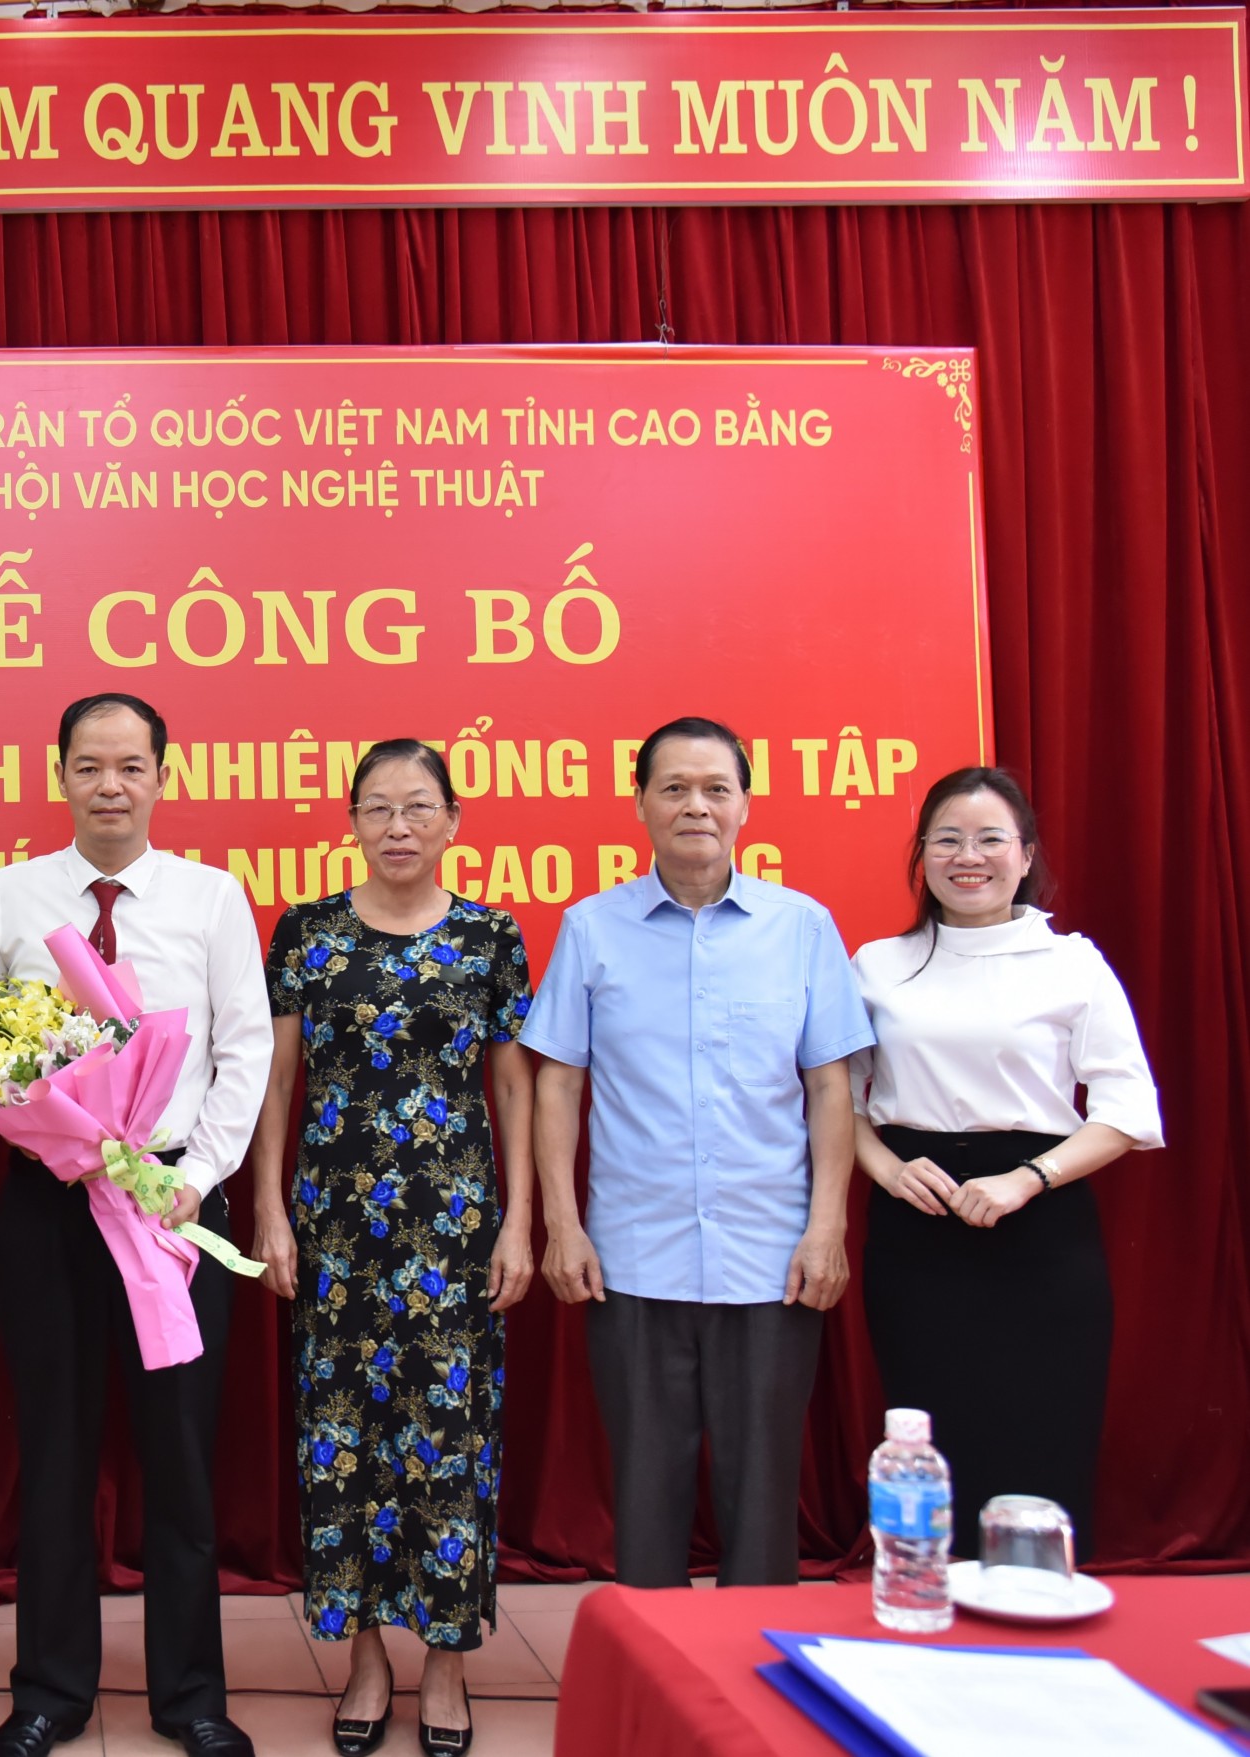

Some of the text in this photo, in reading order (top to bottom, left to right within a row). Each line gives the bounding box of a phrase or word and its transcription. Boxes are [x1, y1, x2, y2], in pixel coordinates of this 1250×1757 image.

[83, 81, 398, 165] QUANG
[422, 81, 649, 155] VINH
[672, 52, 932, 156] MUÔN
[958, 55, 1160, 152] NĂM
[79, 393, 137, 448] TỔ
[151, 394, 281, 448] QUỐC
[295, 399, 383, 456] VIỆT
[396, 408, 489, 446] NAM
[502, 396, 595, 446] TỈNH
[608, 408, 701, 446] CAO
[715, 392, 833, 447] BẰNG
[74, 462, 158, 509] VĂN
[173, 470, 268, 519] HỌC
[282, 460, 399, 518] NGHỆ
[410, 460, 545, 518] THUẬT
[88, 566, 426, 668] CÔNG
[465, 541, 621, 665] BỐ
[418, 715, 590, 799] ỔNG
[791, 725, 918, 809] TẬP
[440, 843, 573, 904] CAO
